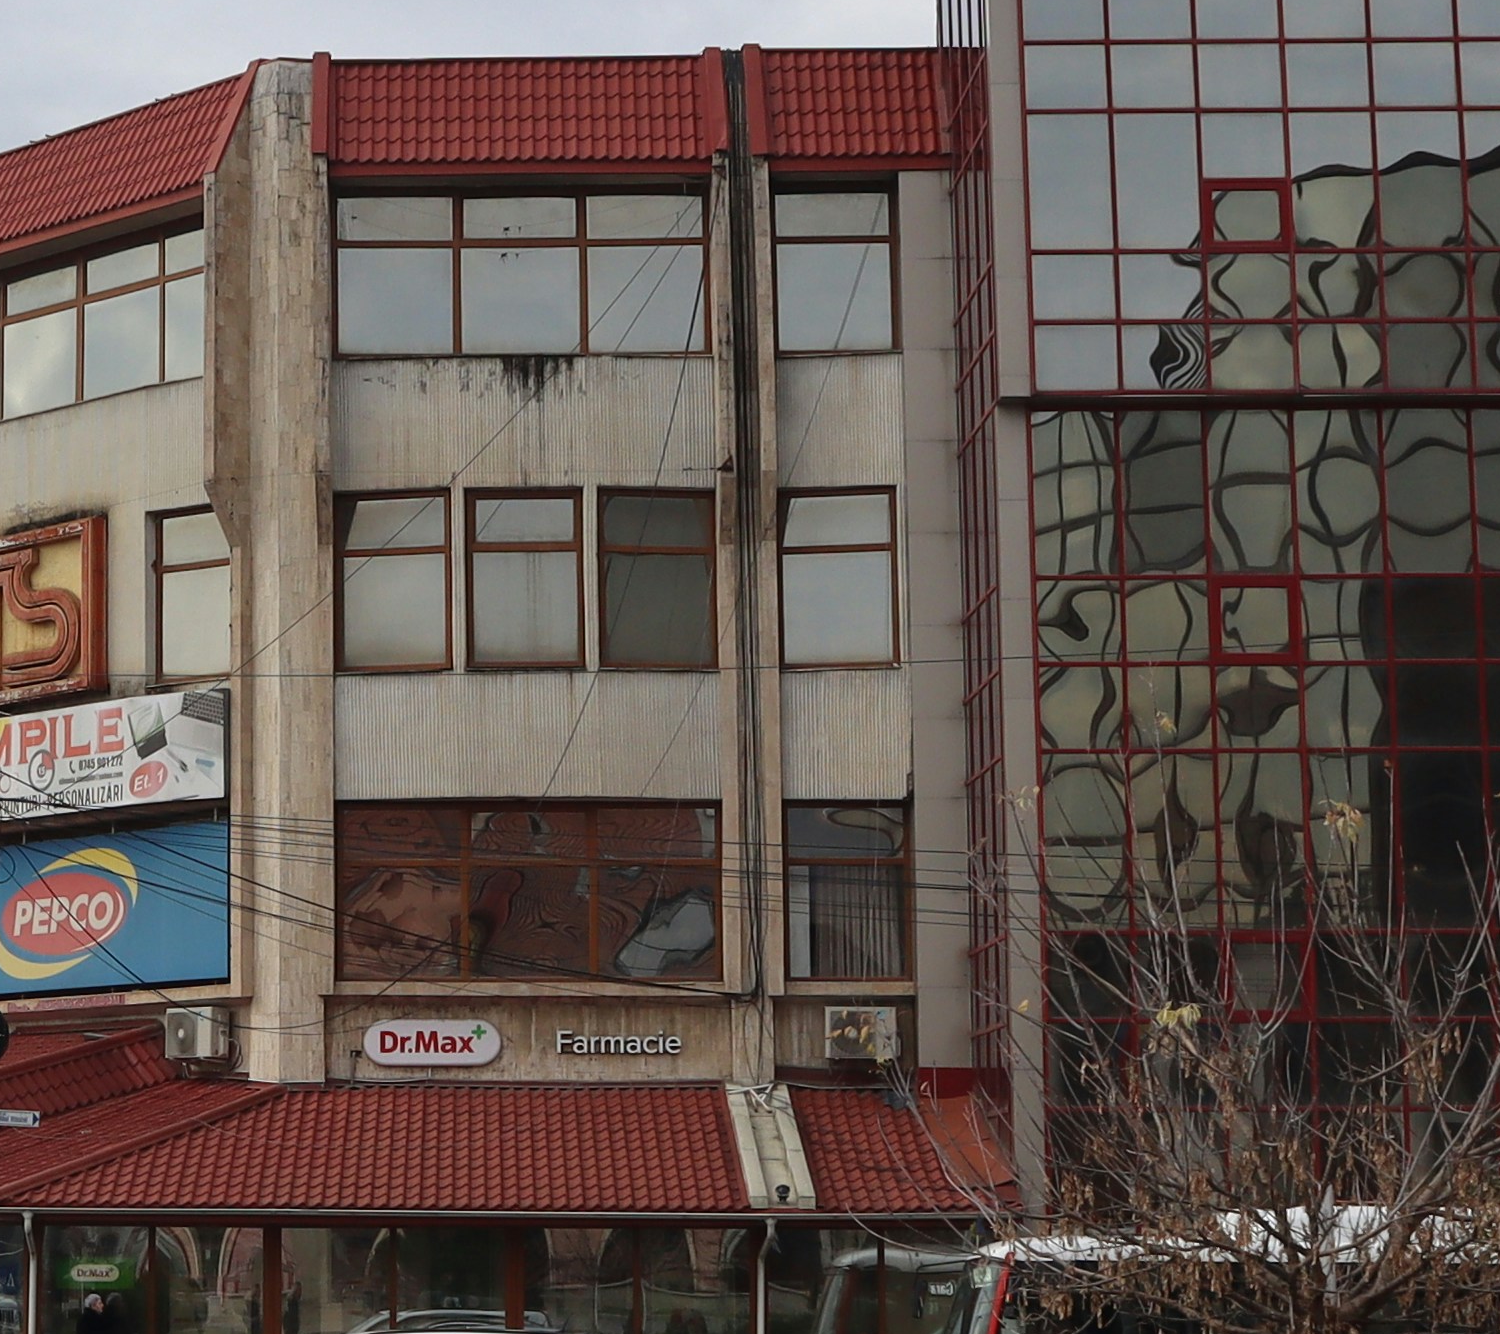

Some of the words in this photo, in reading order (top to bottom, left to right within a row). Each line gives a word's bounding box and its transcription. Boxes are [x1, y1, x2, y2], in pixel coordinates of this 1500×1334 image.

[156, 767, 165, 783] 1
[13, 891, 114, 936] PEPCO
[556, 1029, 682, 1055] Farmacie
